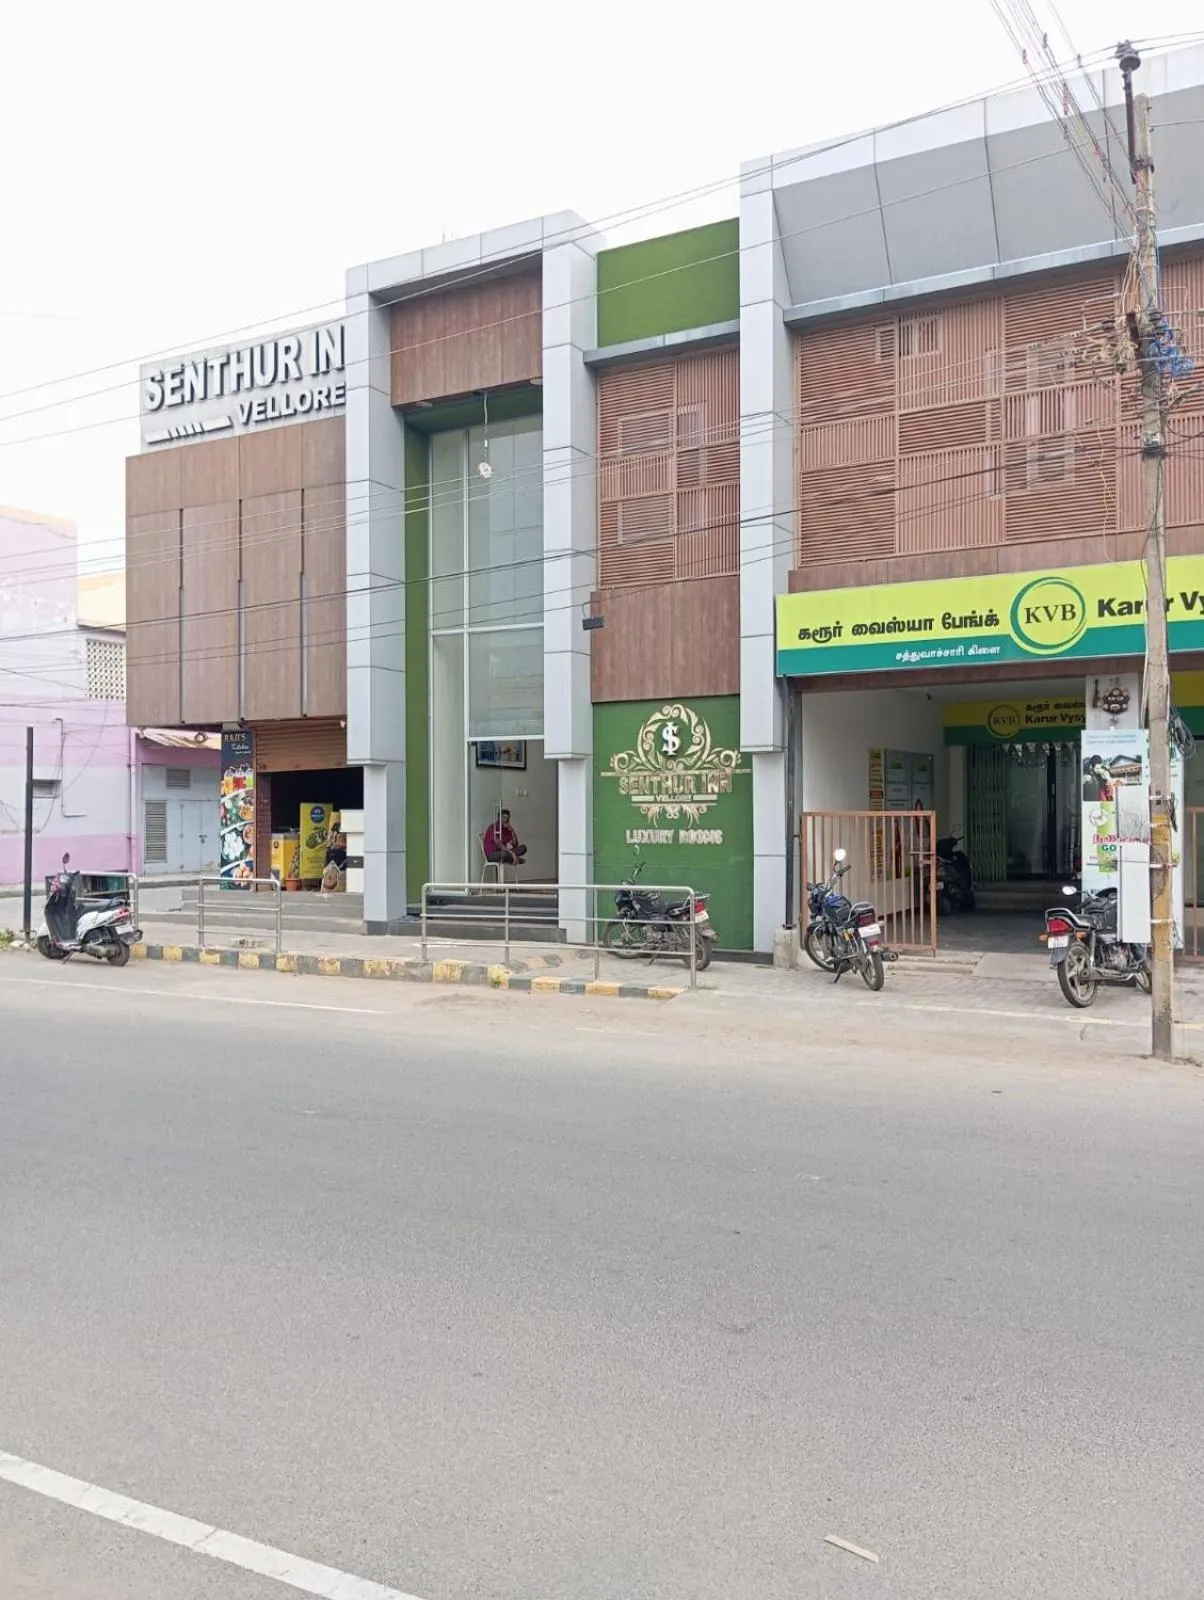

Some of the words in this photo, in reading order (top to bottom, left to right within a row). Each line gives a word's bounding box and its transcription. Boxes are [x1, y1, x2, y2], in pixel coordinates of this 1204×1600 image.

[144, 335, 303, 412] SENTHUR
[237, 381, 346, 425] VELLORE
[1024, 603, 1077, 624] KVB
[1097, 597, 1174, 618] Karr
[798, 620, 843, 644] கரூர்
[852, 616, 934, 637] வைஸ்யா
[942, 608, 1000, 630] பேங்க்
[967, 644, 1001, 656] கிளை
[1025, 713, 1058, 724] Karur
[618, 774, 697, 795] SENTHUR
[626, 829, 675, 844] LUXURY
[679, 829, 723, 845] ROOMS
